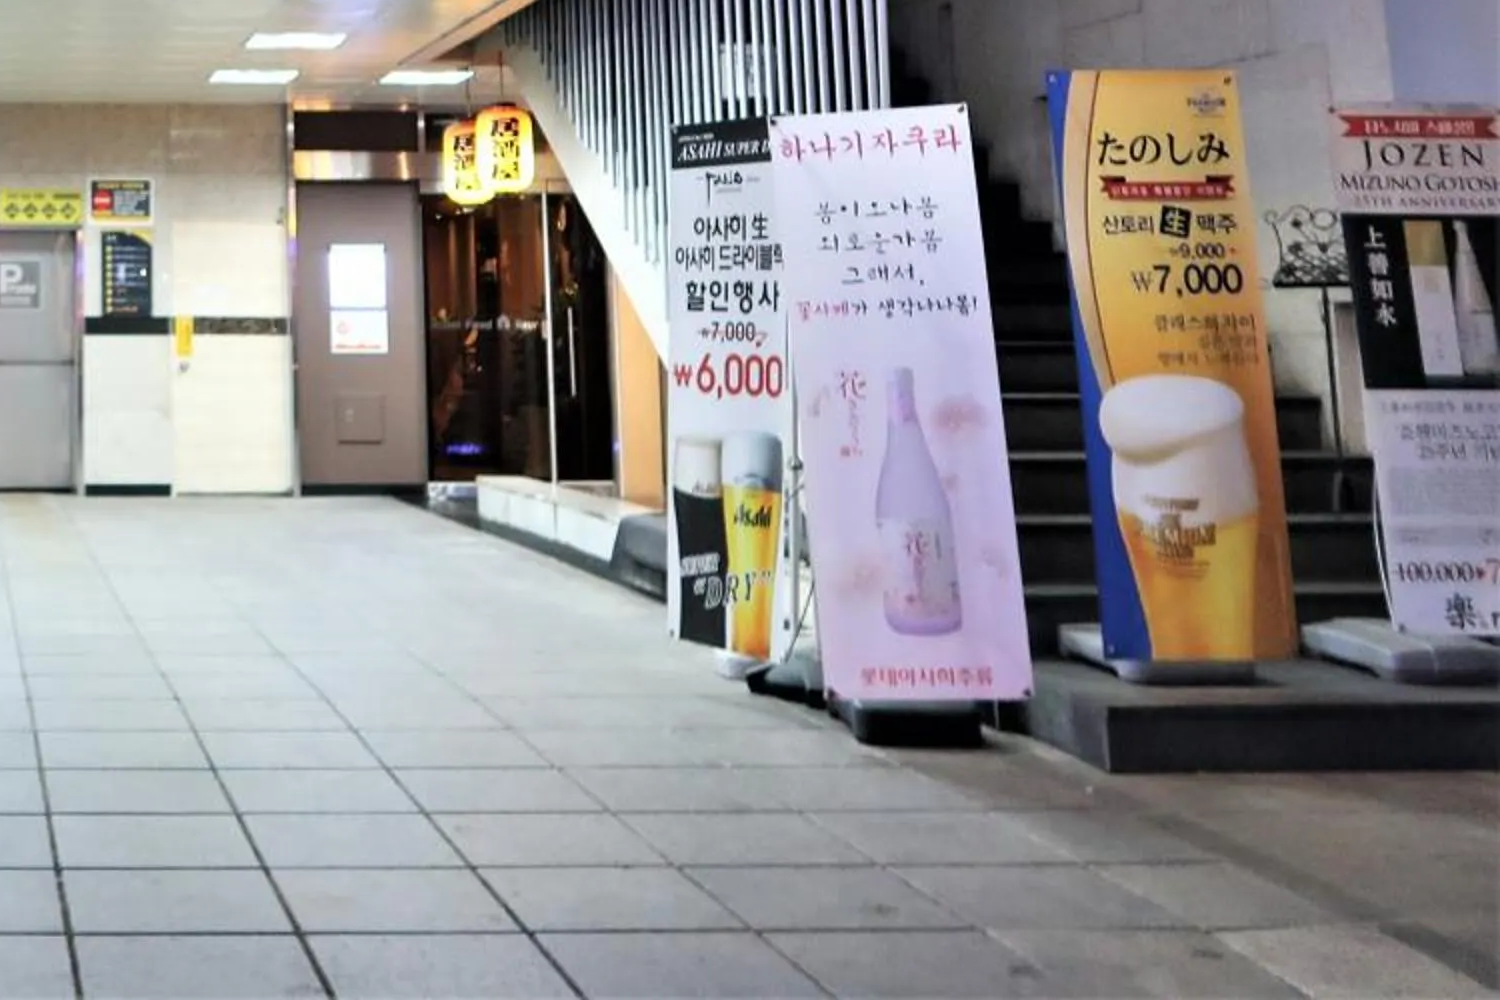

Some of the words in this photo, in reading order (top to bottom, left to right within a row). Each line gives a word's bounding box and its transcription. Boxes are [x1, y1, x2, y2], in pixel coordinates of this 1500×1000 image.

[678, 141, 722, 161] ASAHI
[723, 139, 760, 157] SUPER
[1097, 132, 1230, 166] たのしみ
[1363, 140, 1485, 171] JOZEN
[1340, 174, 1421, 190] MIZUNO
[751, 211, 769, 240] 生
[1103, 214, 1154, 236] 산토리
[1162, 206, 1191, 238] 生
[1196, 213, 1237, 235] 맥주
[1131, 263, 1243, 298] ₩7,000
[674, 352, 784, 400] ₩6,000
[733, 503, 772, 529] Asahi
